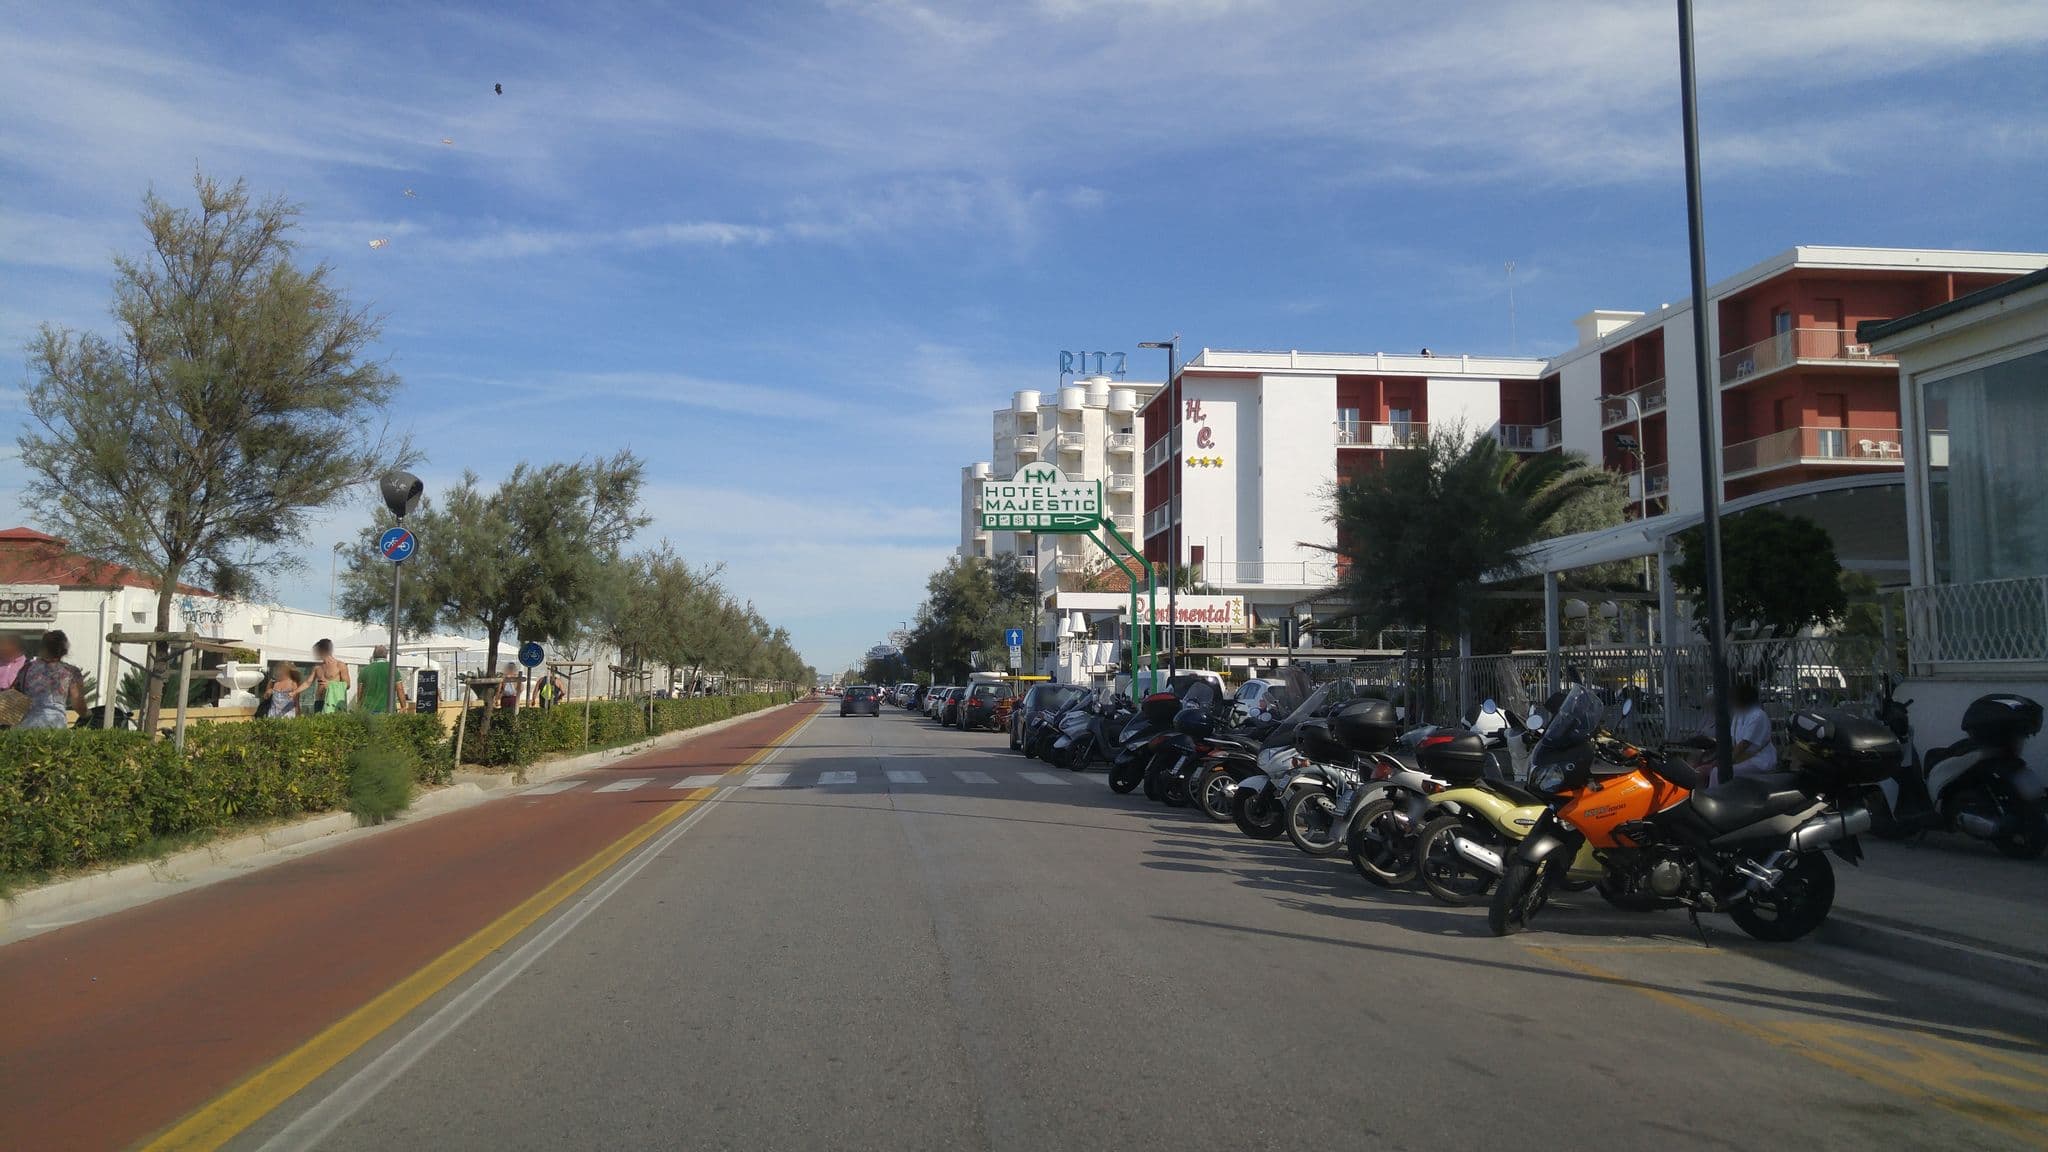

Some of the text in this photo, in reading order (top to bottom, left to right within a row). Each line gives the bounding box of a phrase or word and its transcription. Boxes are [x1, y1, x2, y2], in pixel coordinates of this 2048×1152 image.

[1060, 350, 1126, 375] RITZ
[1025, 470, 1056, 483] HM
[985, 486, 1058, 498] HOTEL
[985, 500, 1095, 511] MAJESTIC
[988, 516, 995, 525] P
